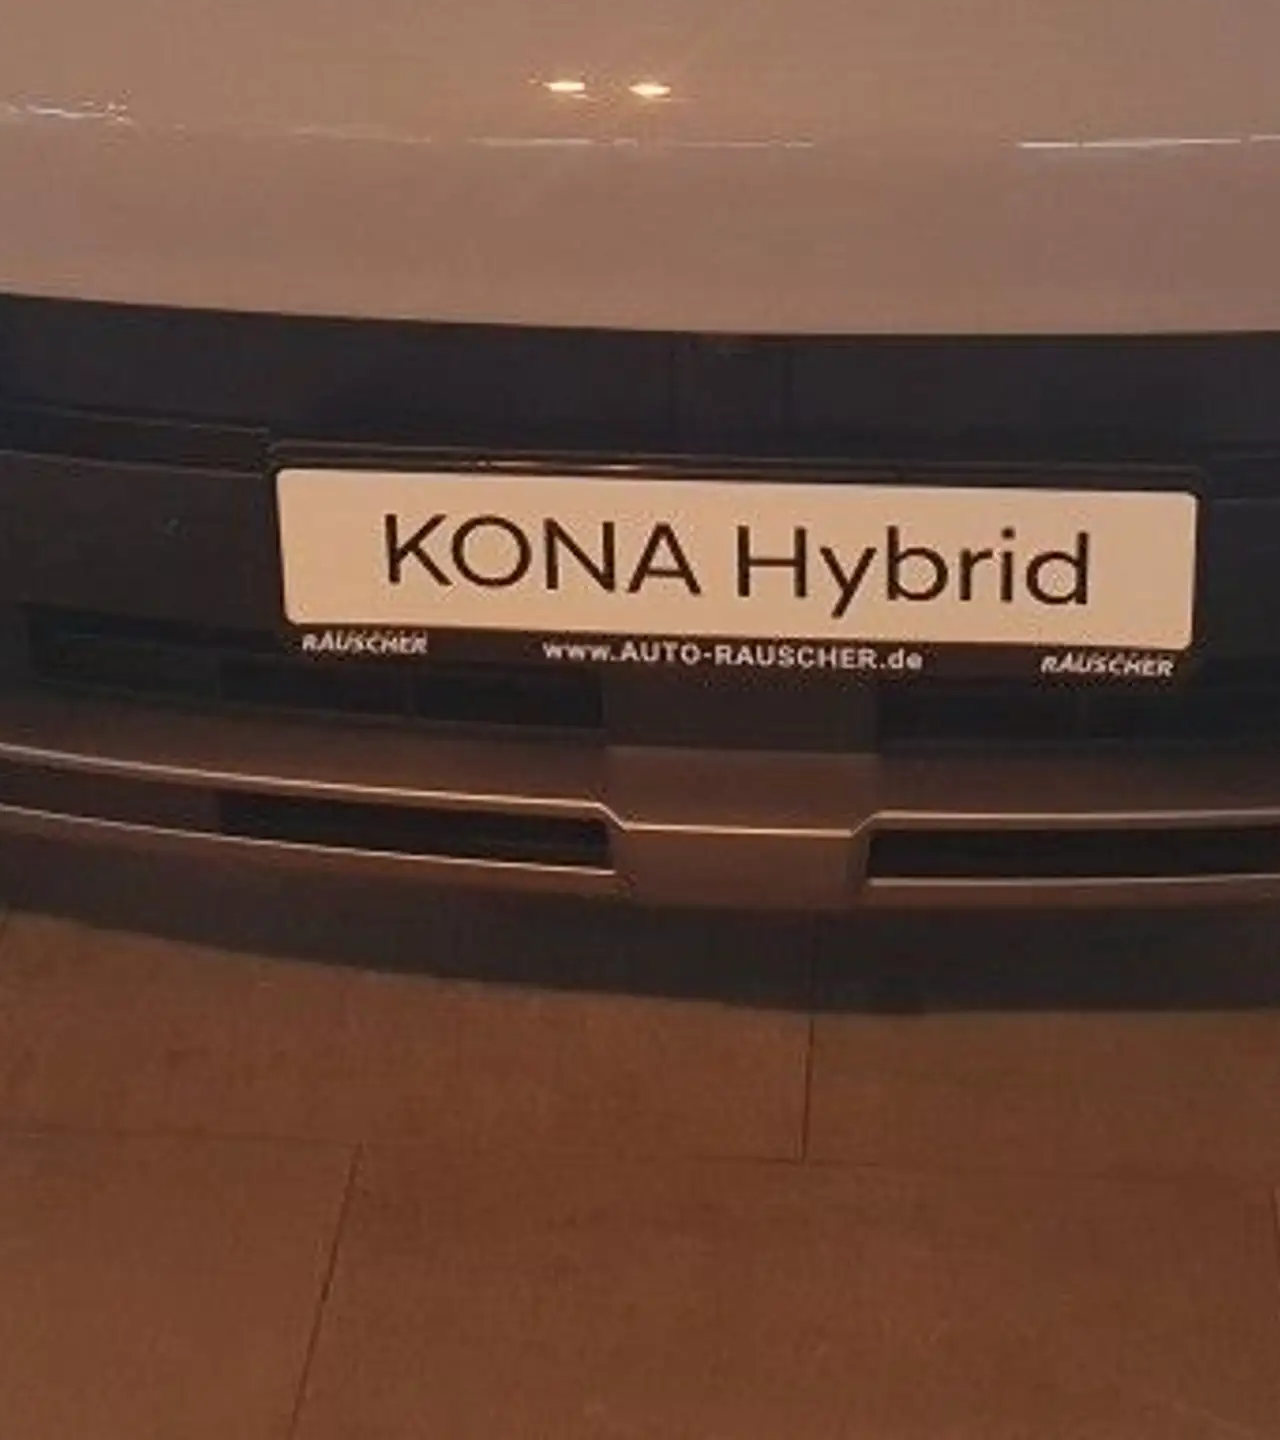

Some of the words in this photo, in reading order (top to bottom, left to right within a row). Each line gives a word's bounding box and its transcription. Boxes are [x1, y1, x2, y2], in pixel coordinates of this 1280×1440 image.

[382, 511, 702, 596] KONA
[736, 524, 1091, 618] Hybrid
[301, 630, 429, 655] RAUSCHER
[541, 640, 924, 671] www.AUTO-RAUSCHER.de
[1039, 651, 1175, 677] RAUSCHER
